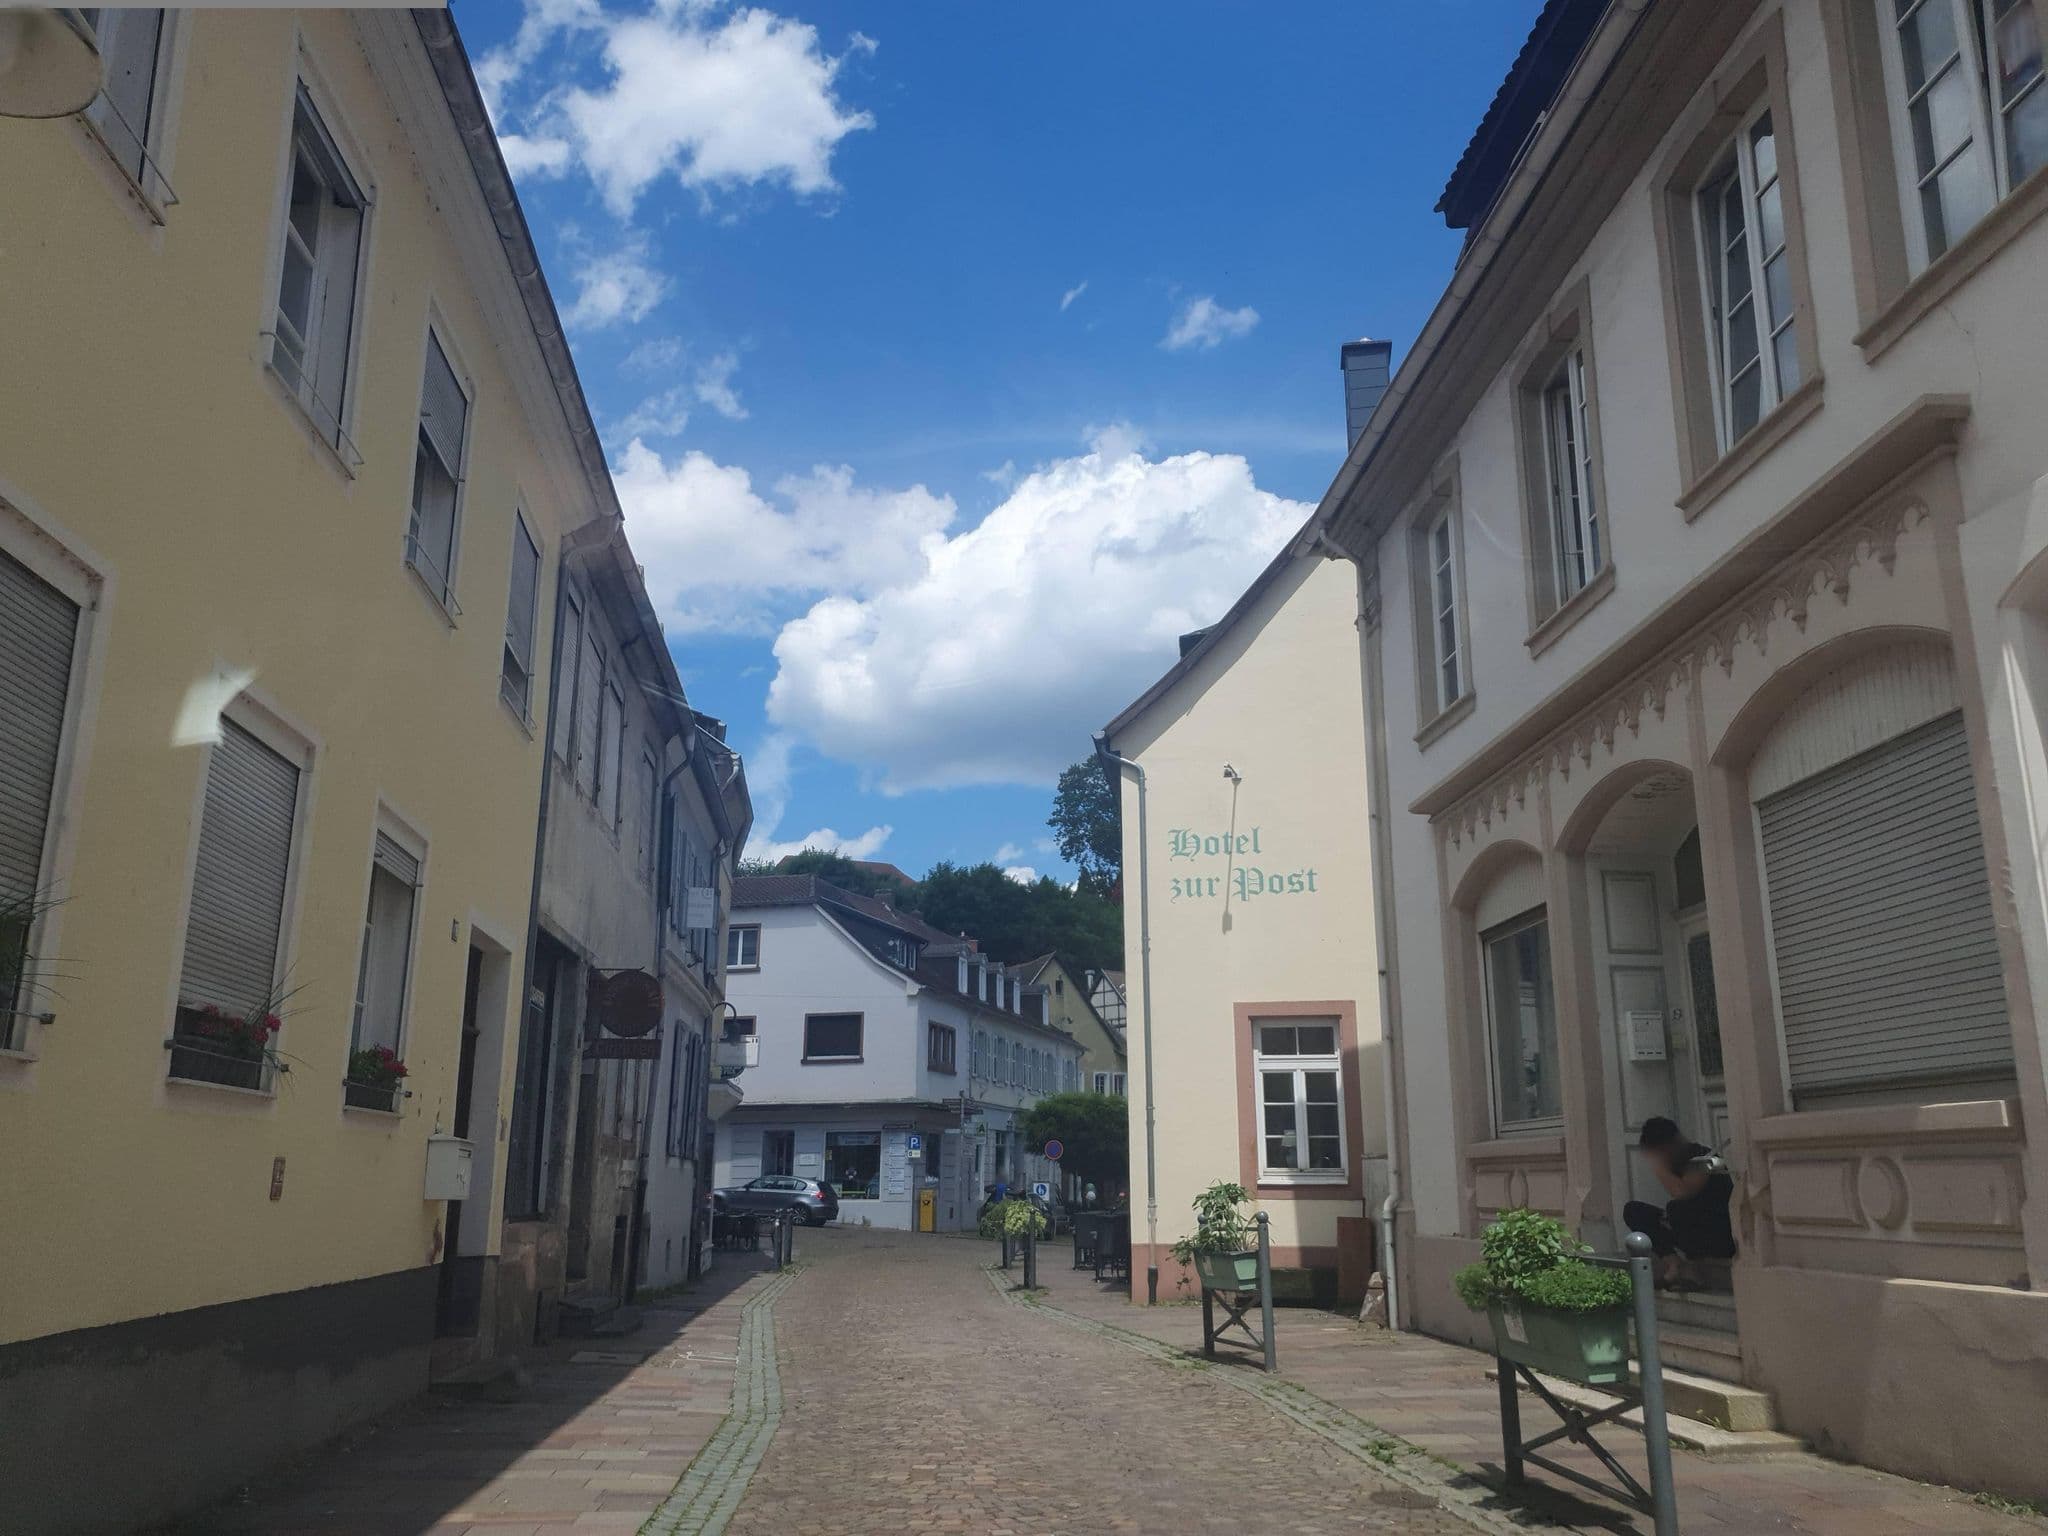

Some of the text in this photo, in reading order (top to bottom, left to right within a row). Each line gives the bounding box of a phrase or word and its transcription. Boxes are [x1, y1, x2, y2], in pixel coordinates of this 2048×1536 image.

[1168, 825, 1263, 862] Hotel
[1170, 866, 1318, 904] zur Post
[910, 1137, 919, 1149] P
